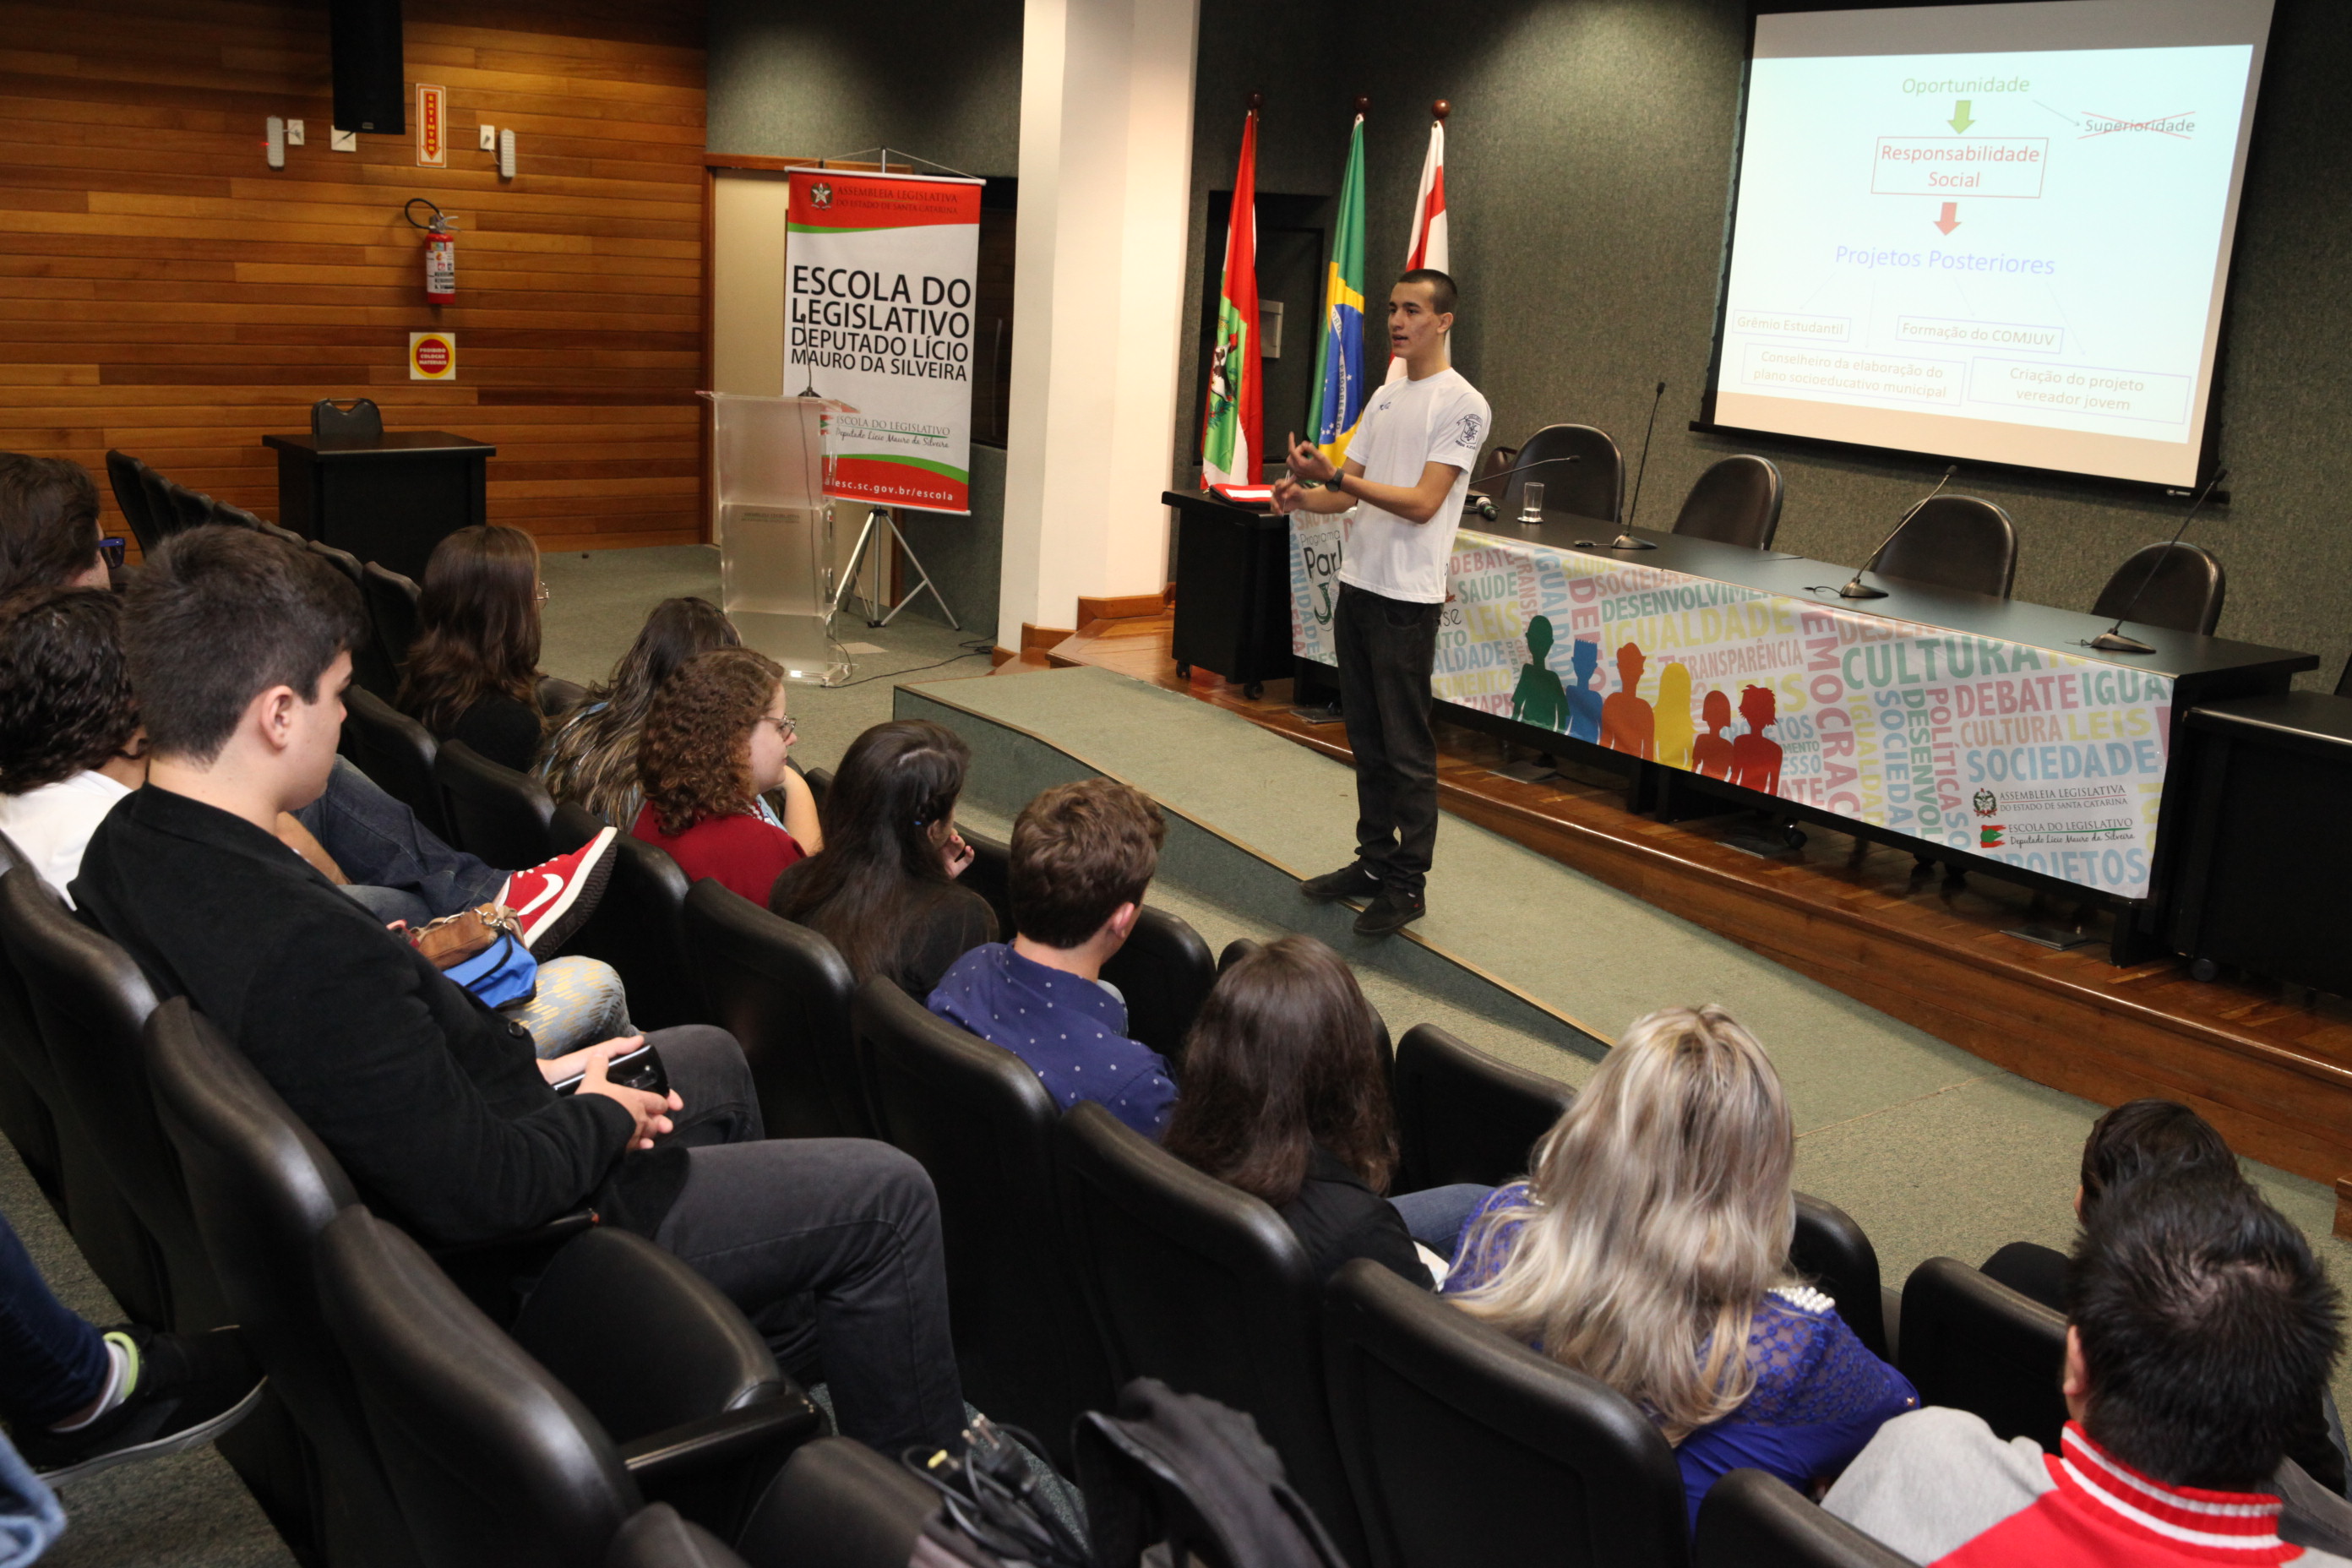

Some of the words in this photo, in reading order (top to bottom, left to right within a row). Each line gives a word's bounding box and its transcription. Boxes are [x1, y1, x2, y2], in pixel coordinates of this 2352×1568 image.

[1901, 75, 2030, 97] Oportunidade
[426, 95, 437, 151] EXTINTOR
[2084, 118, 2196, 135] Superioridade
[1881, 144, 2040, 165] Responsabilidade
[1928, 171, 1980, 188] Social
[836, 186, 894, 199] ASSEMBLEIA
[896, 190, 958, 204] LEGISLATIVA
[893, 204, 917, 212] SANTA
[919, 205, 957, 215] CATARINA
[1835, 245, 1921, 270] Projetos
[1928, 248, 2055, 275] Posteriores
[793, 264, 912, 304] ESCOLA
[923, 275, 971, 309] DO
[792, 297, 970, 339] LEGISLATIVO
[1737, 316, 1781, 331] Grêmio
[1783, 319, 1843, 335] Estudantil
[792, 326, 906, 357] DEPUTADO
[912, 335, 968, 363] LÍCIO
[1902, 322, 1967, 340] Formação
[1971, 328, 1988, 340] do
[1993, 329, 2055, 346] COMJUV
[792, 348, 856, 370] MAURO
[861, 355, 885, 373] DA
[890, 357, 967, 382] SILVEIRA
[1761, 351, 1832, 368] Conselheiro
[1834, 357, 1849, 370] da
[1853, 358, 1923, 378] elaboração
[1925, 367, 1943, 379] do
[1753, 368, 1786, 382] plano
[1788, 372, 1880, 391] socioeducativo
[1883, 382, 1947, 400] municipal
[2010, 367, 2062, 385] Criação
[2066, 372, 2085, 386] do
[2089, 377, 2144, 393] projeto
[2016, 389, 2082, 406] vereador
[2083, 395, 2131, 411] jovem
[871, 418, 887, 429] DO
[890, 421, 950, 437] LEGISLATIVO
[1299, 530, 1341, 547] Programa
[1449, 548, 1514, 576] DEBATE
[1457, 570, 1518, 605] SAÚDE
[1463, 601, 1522, 644] LEIS
[1603, 596, 1796, 659] IGUALDADE
[1678, 637, 1804, 682] TRANSPARÊNCIA
[1842, 634, 2043, 690] CULTURA
[1954, 673, 2079, 719] DEBATE
[1960, 714, 2063, 749] CULTURA
[2066, 707, 2152, 743] LEIS
[1965, 739, 2159, 784] SOCIEDADE
[1999, 791, 2056, 802] ASSEMBLEIA
[2058, 785, 2126, 799] LEGISLATIVA
[2000, 803, 2012, 812] DO
[2013, 802, 2042, 812] ESTADO
[2044, 801, 2055, 810] DE
[2056, 799, 2082, 809] SANTA
[2083, 797, 2128, 808] CATARINA
[2008, 822, 2044, 834] ESCOLA
[2047, 822, 2061, 832] DO
[2065, 817, 2133, 831] LEGISLATIVO
[2010, 835, 2044, 849] Deputado
[2066, 834, 2089, 844] Mauro
[2091, 832, 2103, 842] da
[2104, 830, 2136, 841] Silveira
